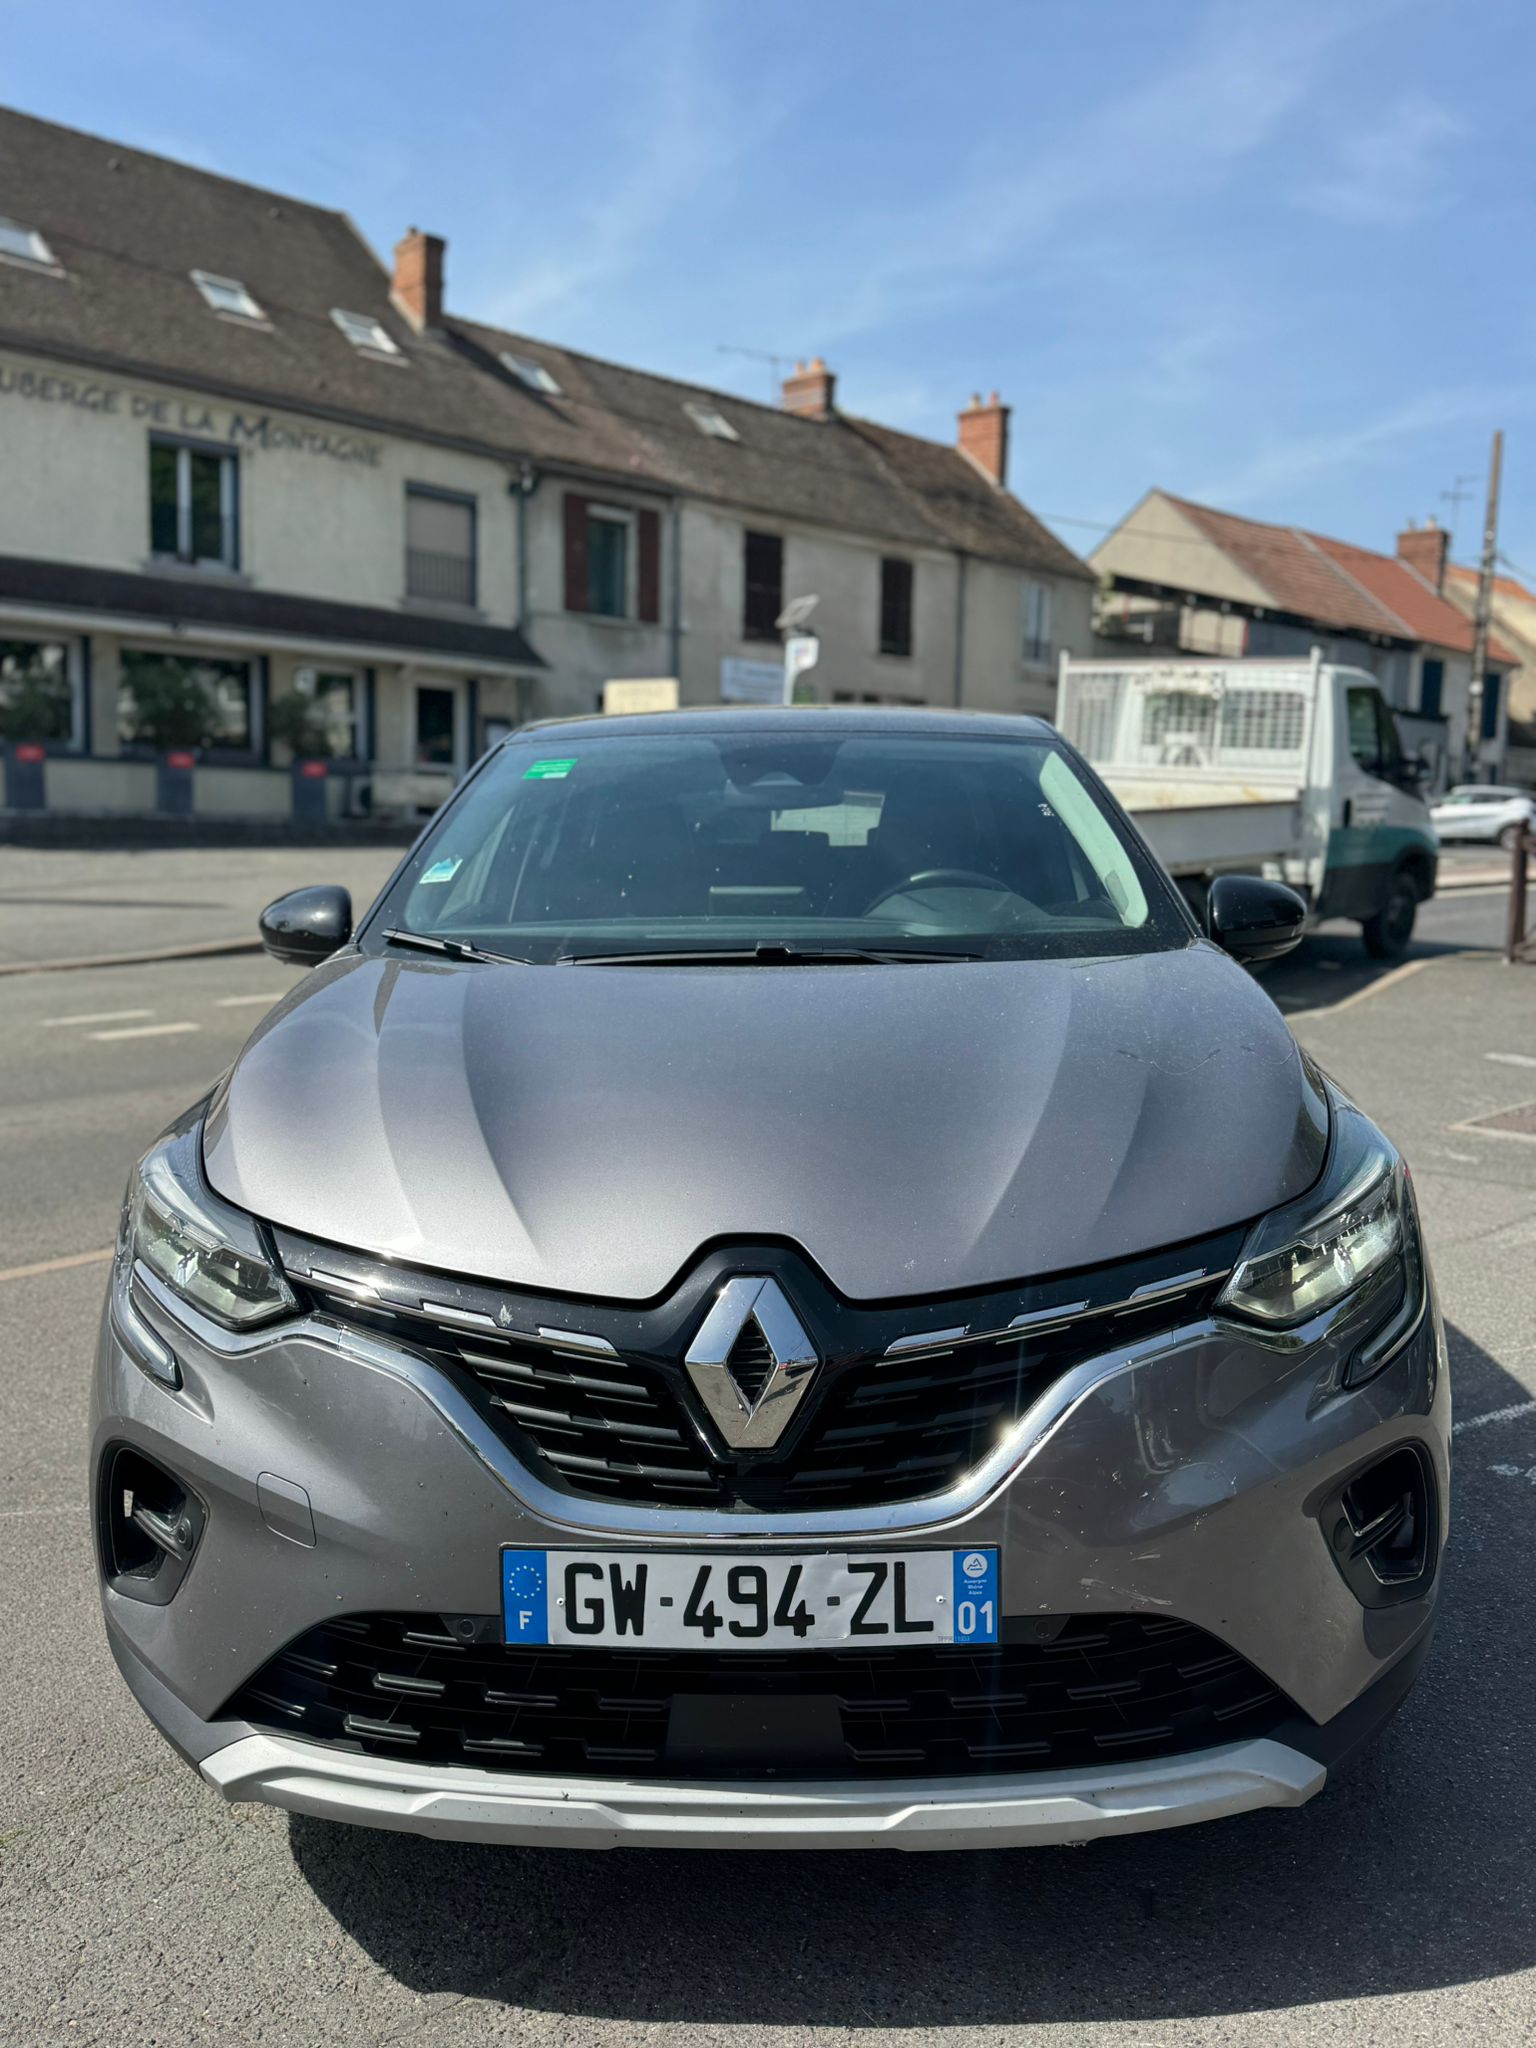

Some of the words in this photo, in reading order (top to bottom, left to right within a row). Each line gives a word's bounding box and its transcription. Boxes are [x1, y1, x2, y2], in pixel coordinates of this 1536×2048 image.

[130, 396, 169, 423] DE
[179, 402, 215, 433] LA
[564, 1561, 934, 1638] GW-494-ZL
[958, 1600, 993, 1635] 01
[519, 1610, 533, 1630] F
